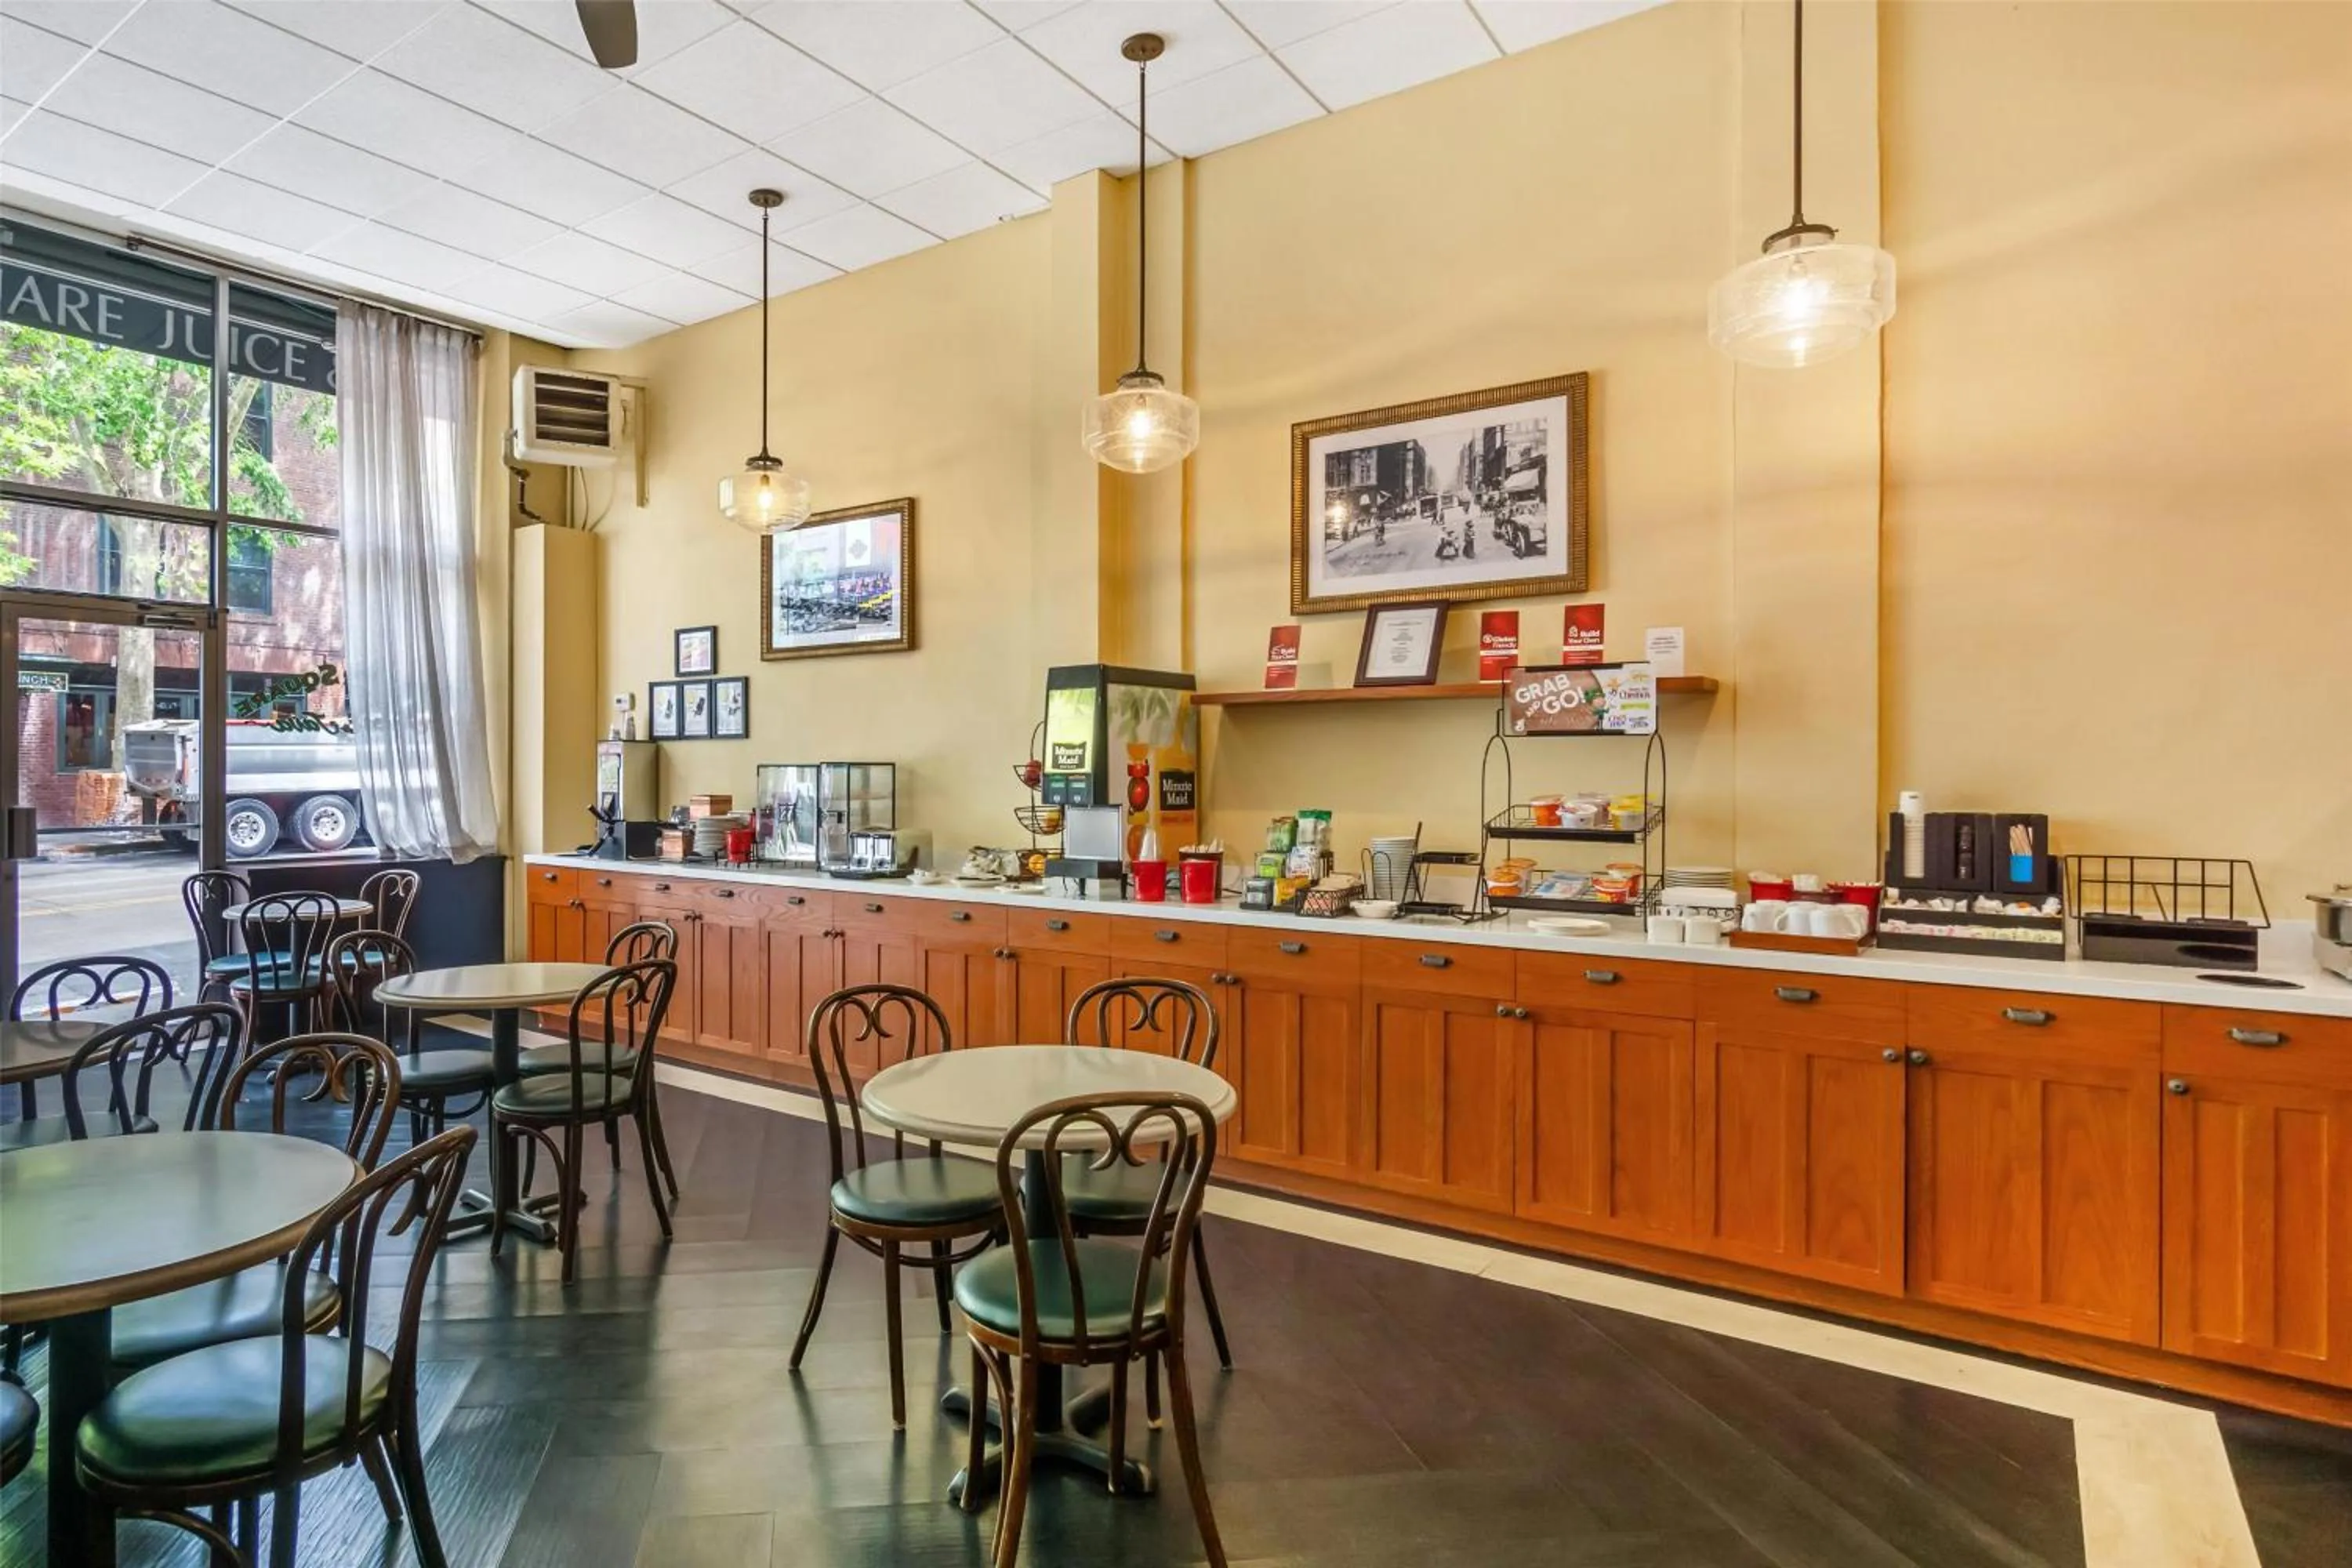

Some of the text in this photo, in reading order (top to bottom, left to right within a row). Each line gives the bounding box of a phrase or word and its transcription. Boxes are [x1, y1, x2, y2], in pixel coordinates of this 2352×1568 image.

[0, 270, 125, 339] ARE
[157, 310, 307, 383] JUICE
[1515, 673, 1570, 703] GRAB
[1542, 686, 1586, 714] GO!
[1054, 746, 1083, 755] Minute
[1058, 755, 1079, 764] Maid
[1163, 778, 1192, 791] Minute
[1167, 791, 1189, 805] Maid
